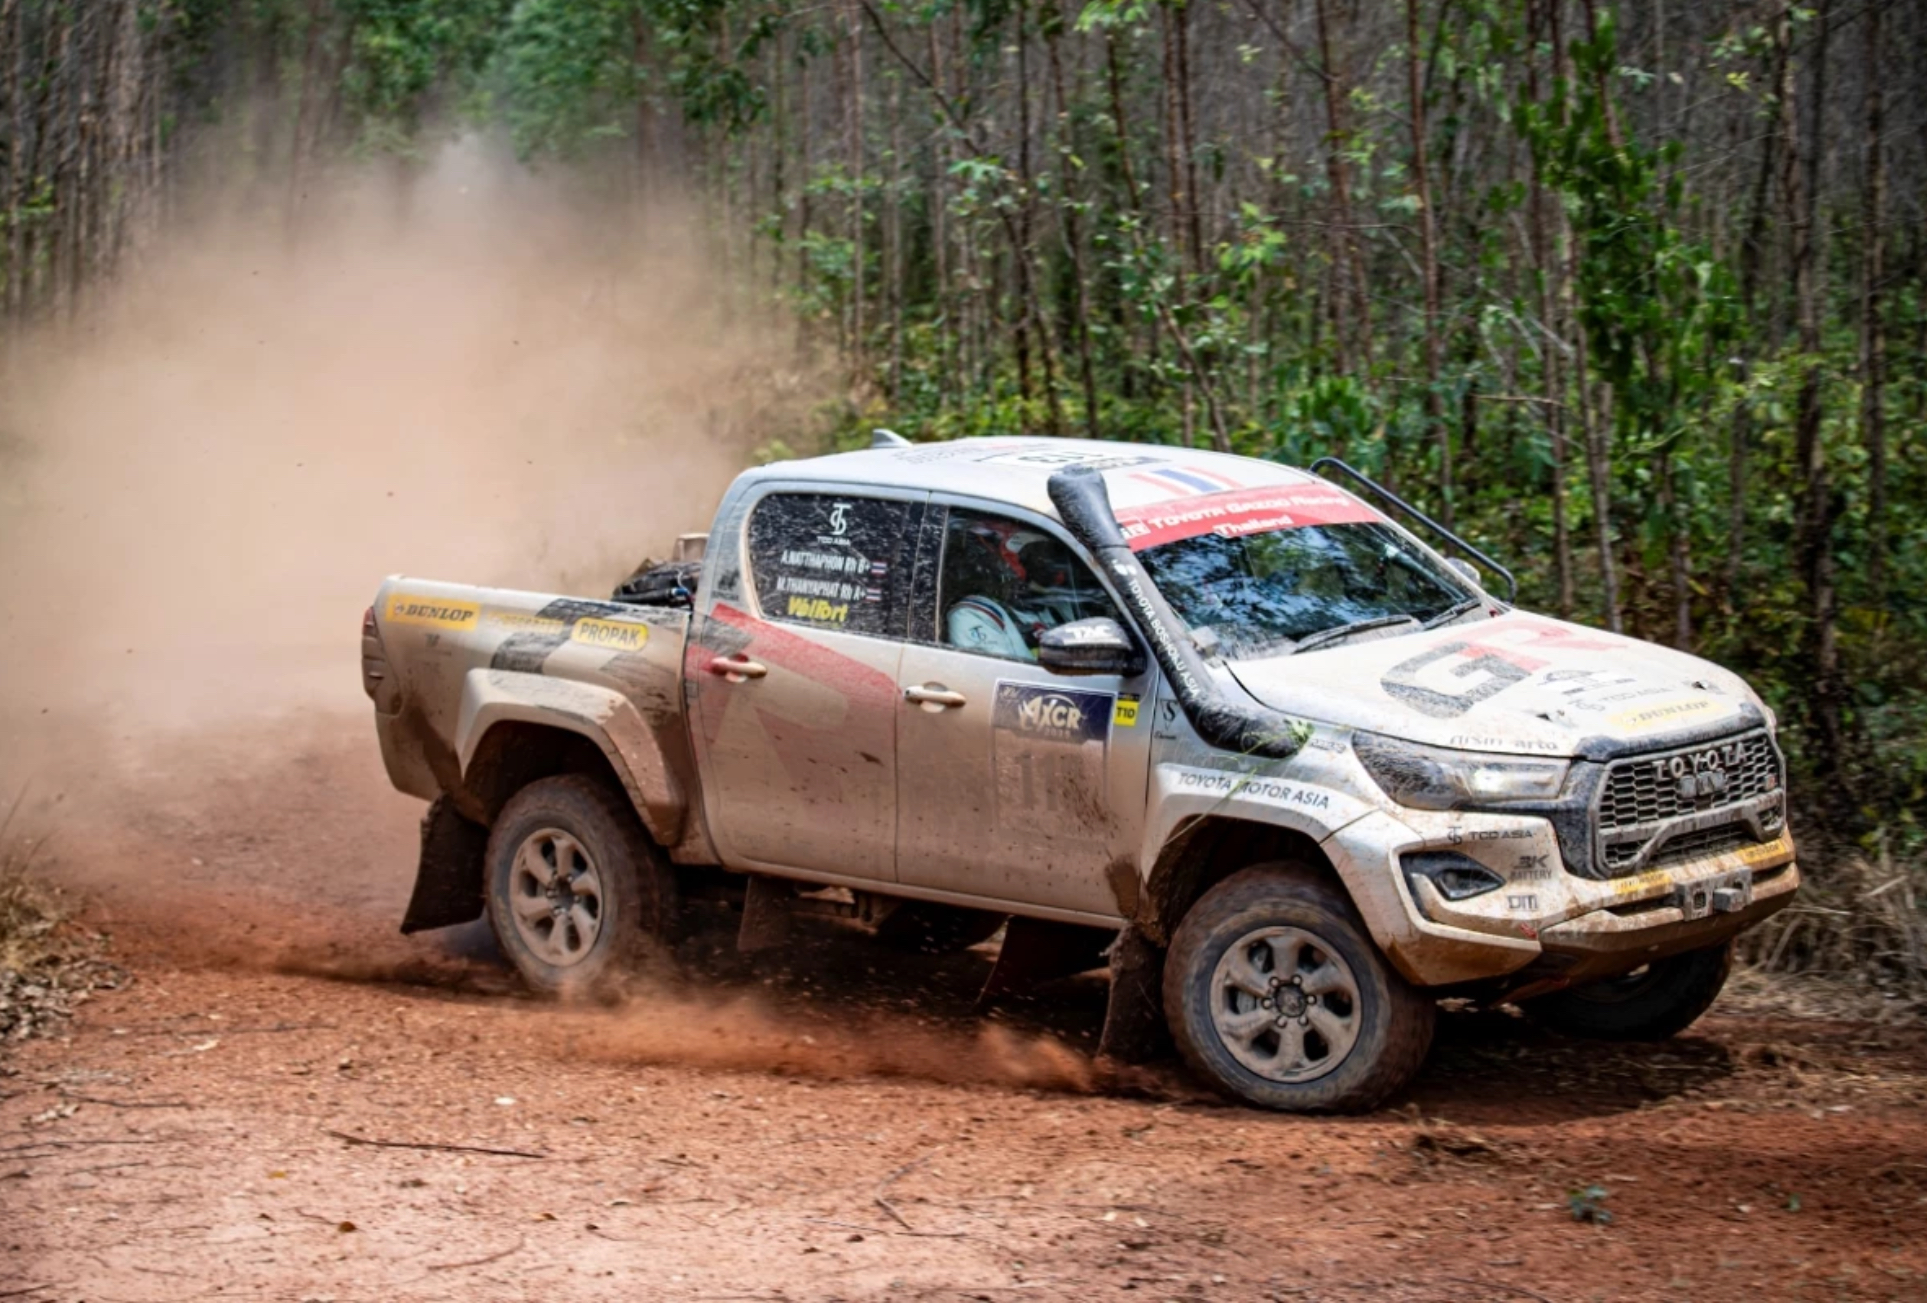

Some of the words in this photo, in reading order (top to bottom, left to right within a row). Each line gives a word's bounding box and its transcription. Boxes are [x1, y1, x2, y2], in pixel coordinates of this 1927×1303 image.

[404, 604, 474, 622] DUNLOP
[578, 621, 642, 647] PROPAK
[1129, 579, 1156, 619] TOYOTA
[1181, 669, 1201, 699] ASIA
[1652, 742, 1748, 781] TOYOTA
[1178, 772, 1232, 791] TOYOTA
[1237, 780, 1293, 799] MOTOR
[1292, 790, 1330, 809] ASIA
[1468, 831, 1500, 841] TCD
[1501, 829, 1534, 839] ASIA
